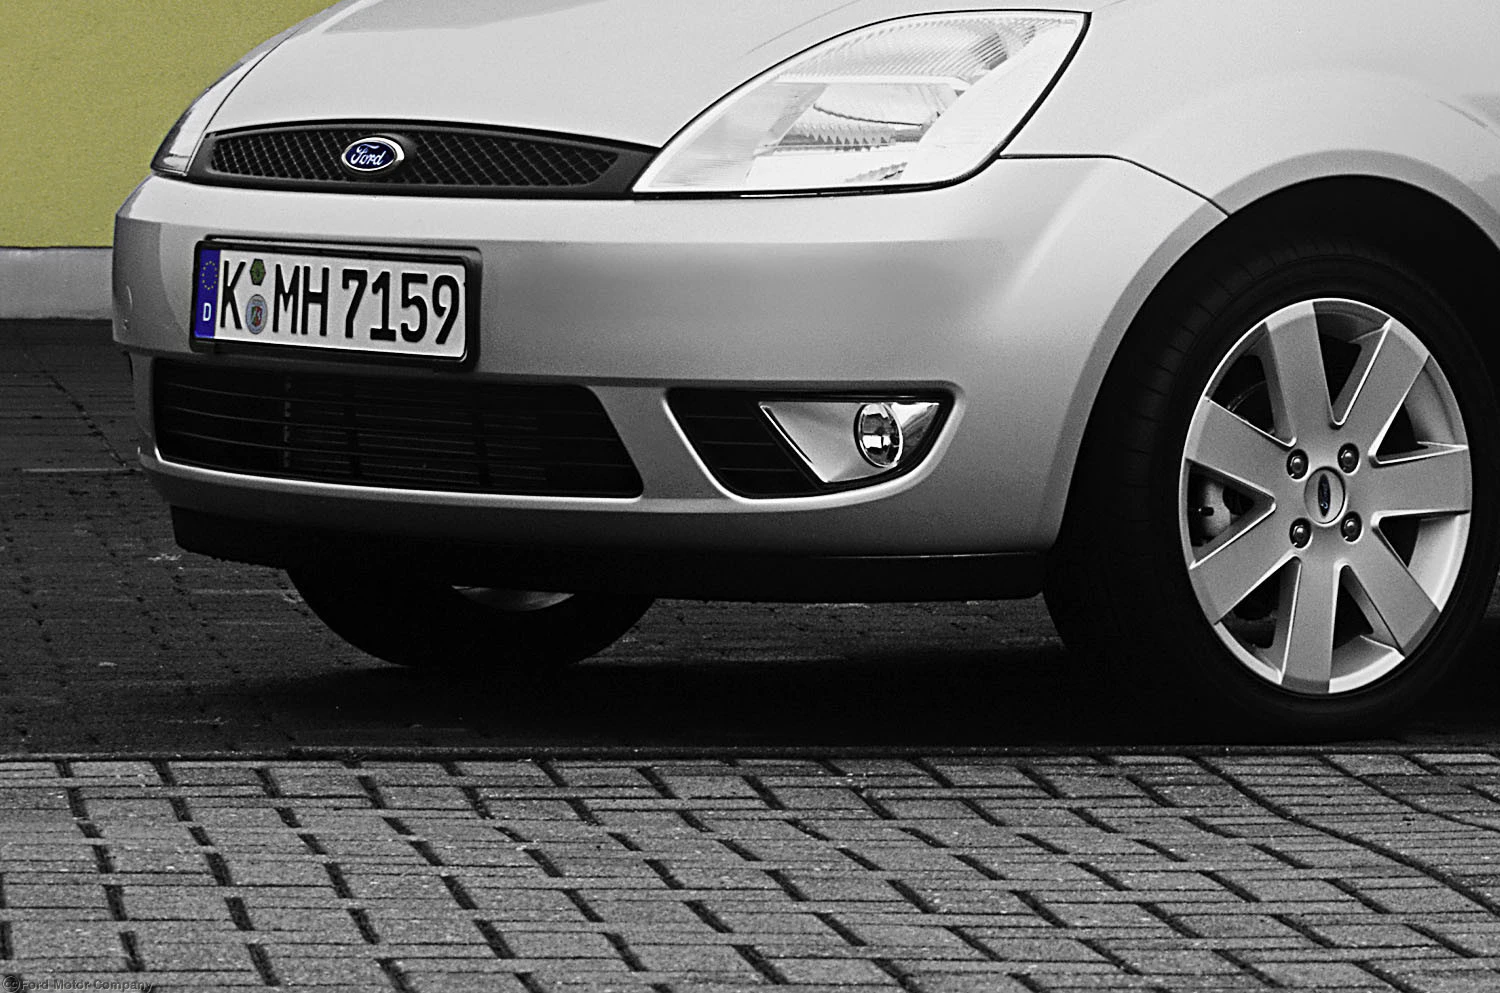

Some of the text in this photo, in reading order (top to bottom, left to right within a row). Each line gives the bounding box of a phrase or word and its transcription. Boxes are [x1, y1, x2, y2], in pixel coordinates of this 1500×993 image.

[350, 143, 387, 166] Ford
[202, 302, 212, 322] D
[219, 260, 460, 344] K MH 7159
